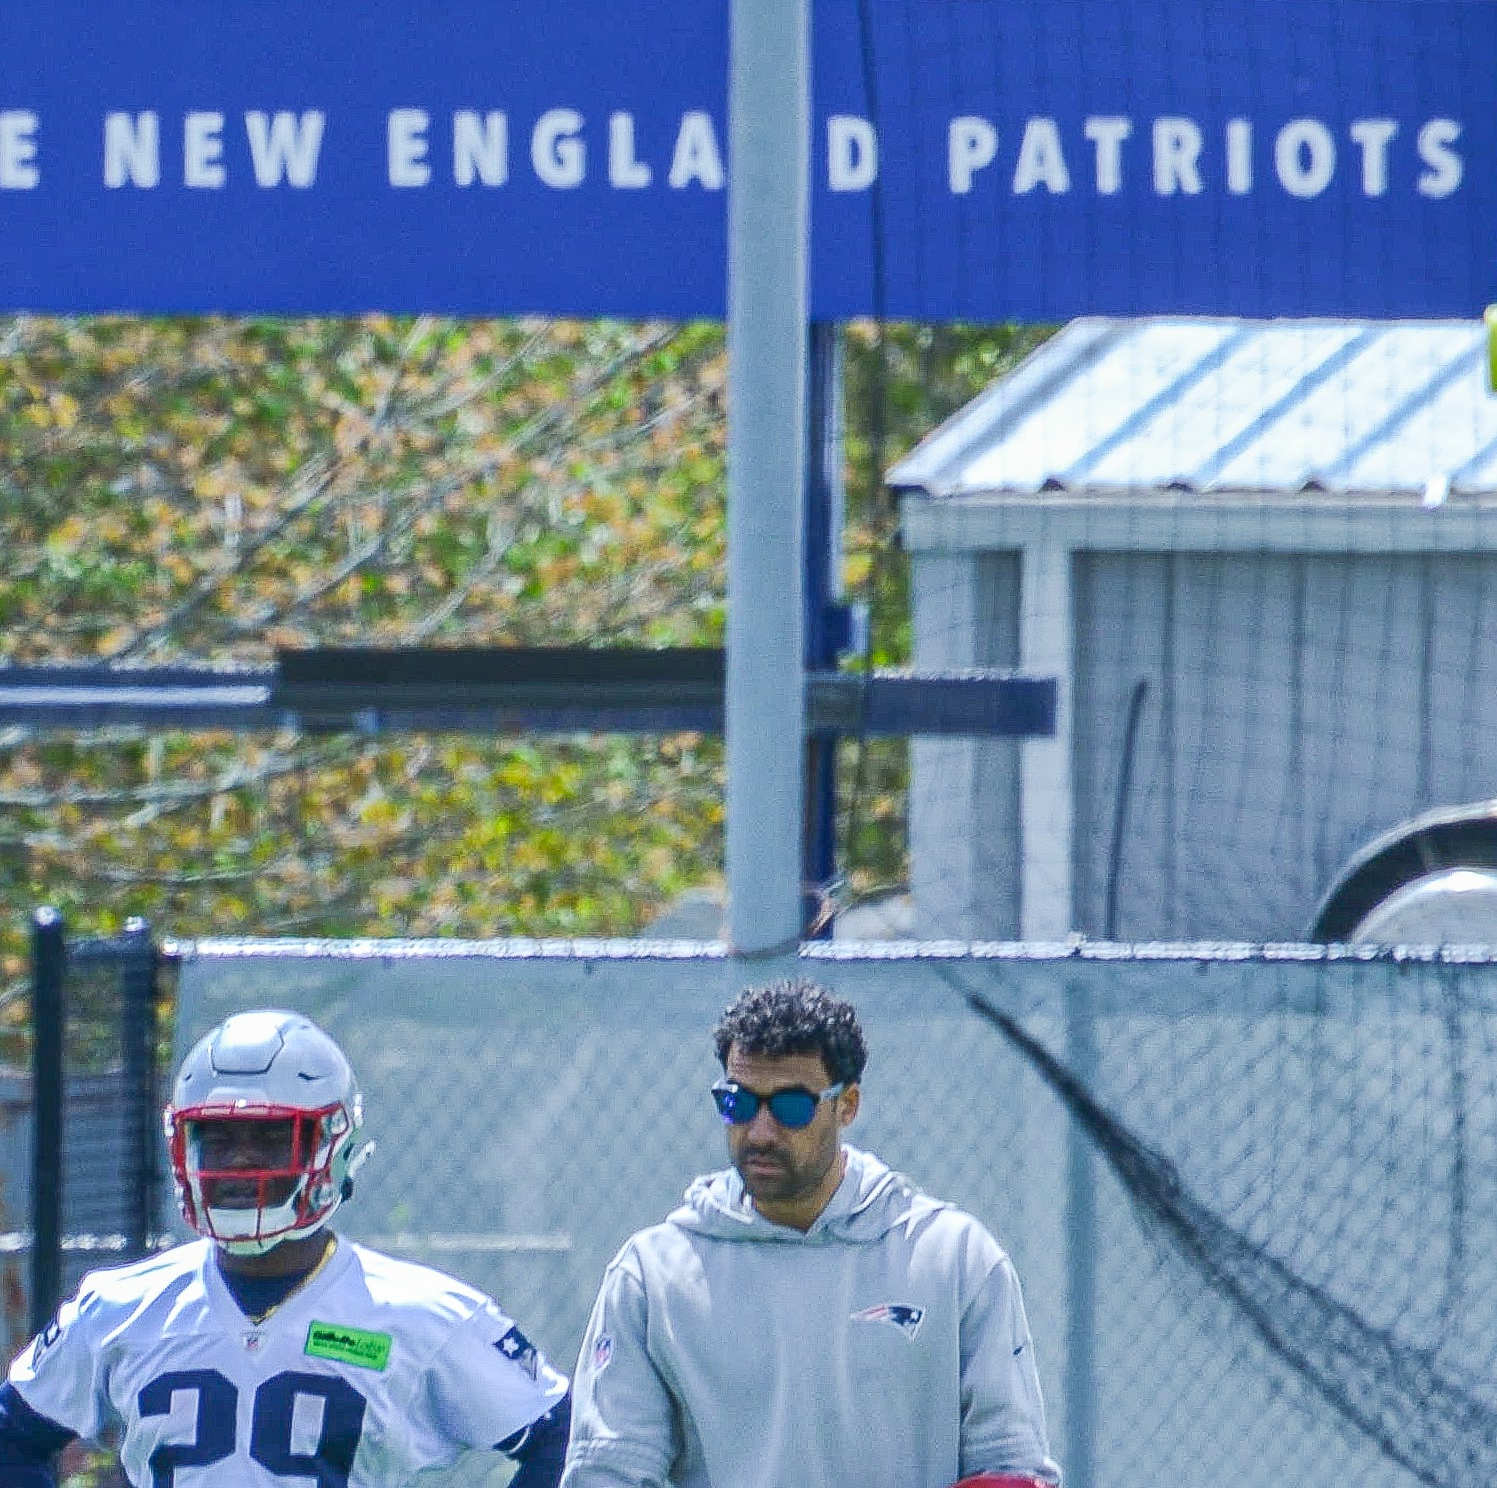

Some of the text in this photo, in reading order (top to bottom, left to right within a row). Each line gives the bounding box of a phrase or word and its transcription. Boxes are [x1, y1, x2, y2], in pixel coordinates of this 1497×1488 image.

[104, 111, 324, 188] NEW
[388, 109, 877, 191] ENGLAD
[949, 116, 1461, 197] PATRIOTS
